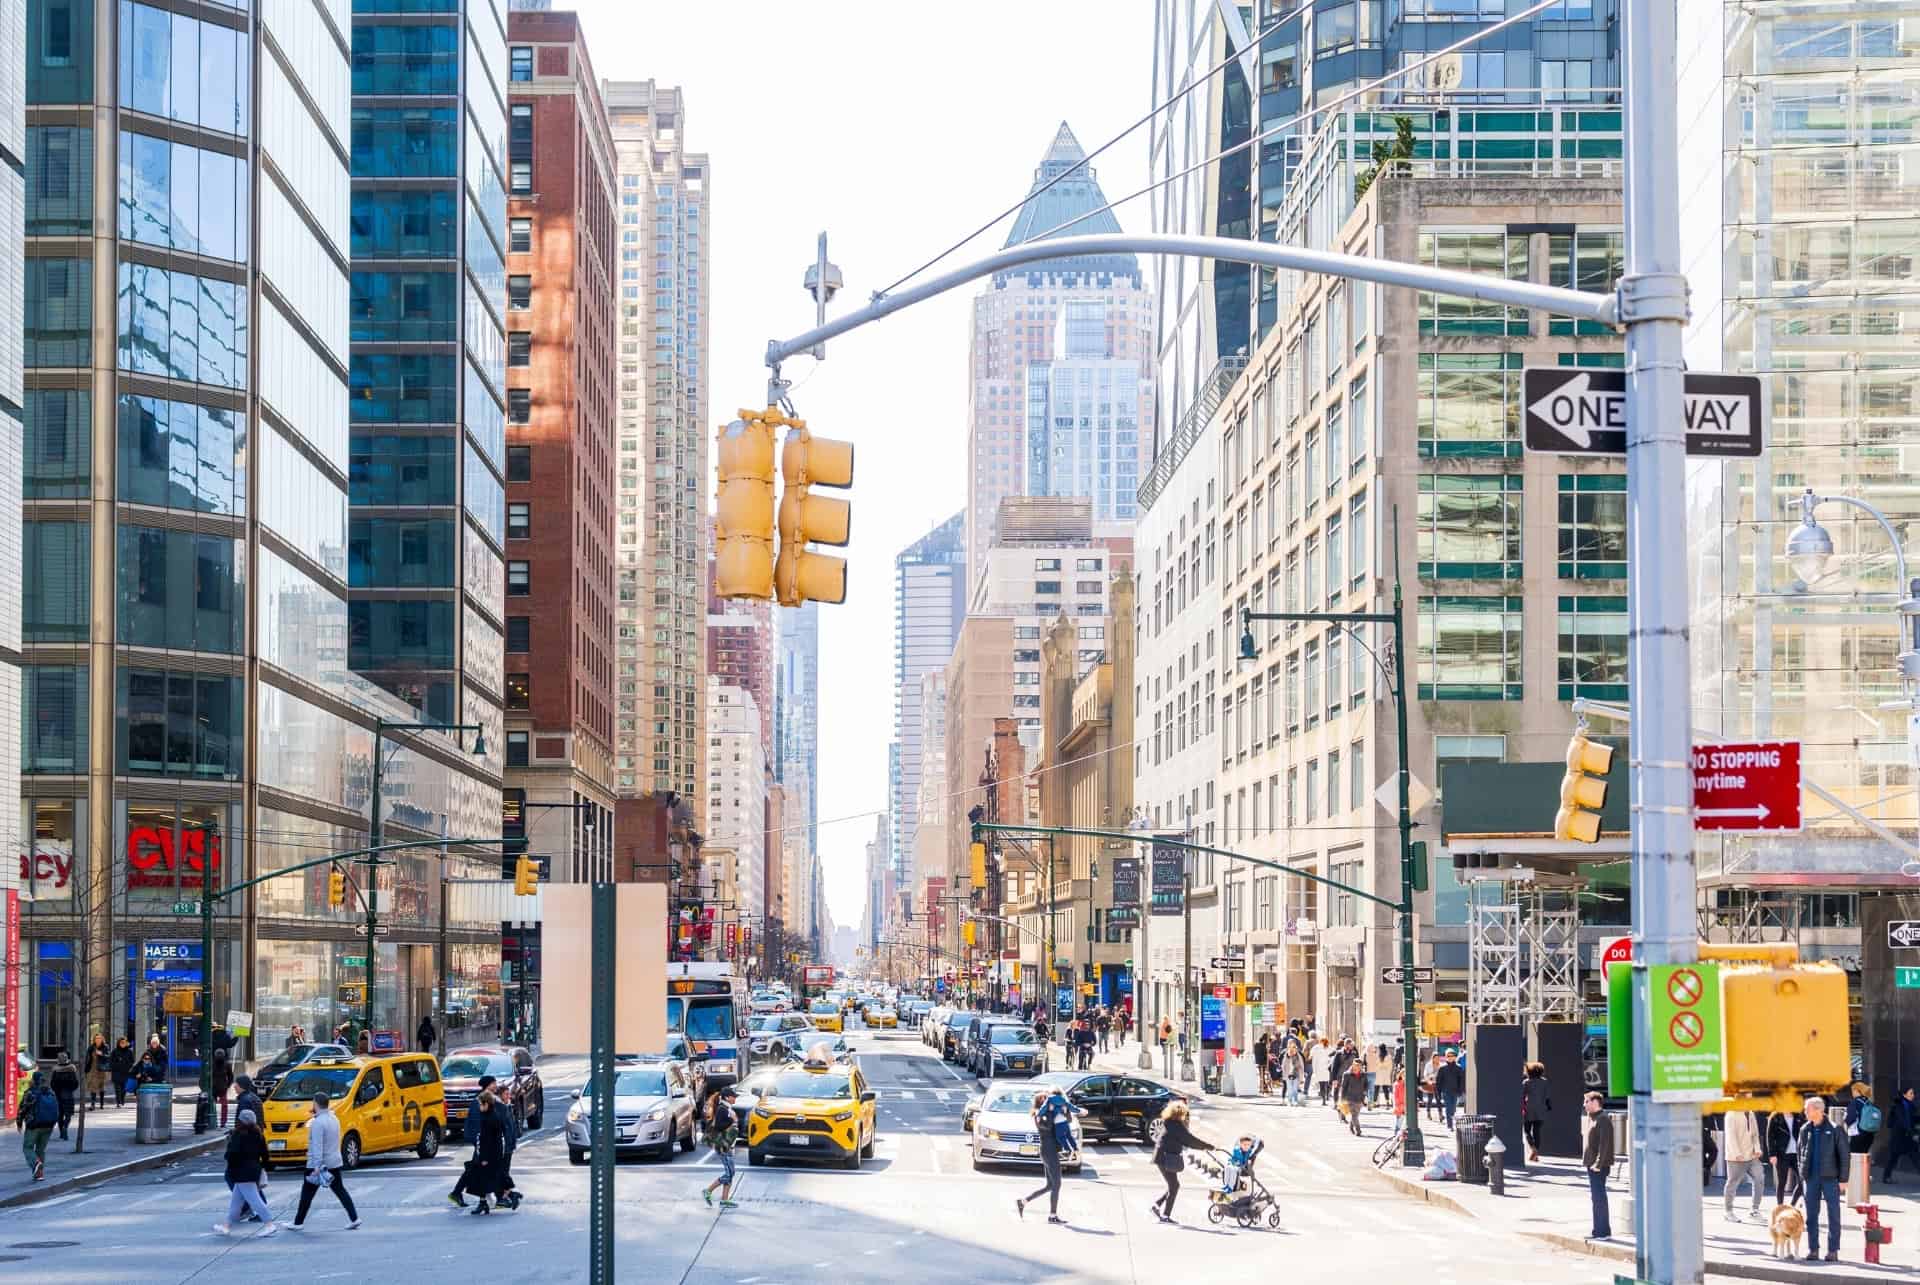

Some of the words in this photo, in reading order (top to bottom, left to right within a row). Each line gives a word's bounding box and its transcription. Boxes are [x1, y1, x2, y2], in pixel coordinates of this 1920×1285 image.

[1551, 395, 1626, 427] ONE
[1710, 751, 1780, 769] STOPPING
[128, 826, 221, 871] CVS
[1897, 930, 1920, 939] ONE
[144, 946, 177, 957] HASE
[1611, 949, 1626, 959] DO
